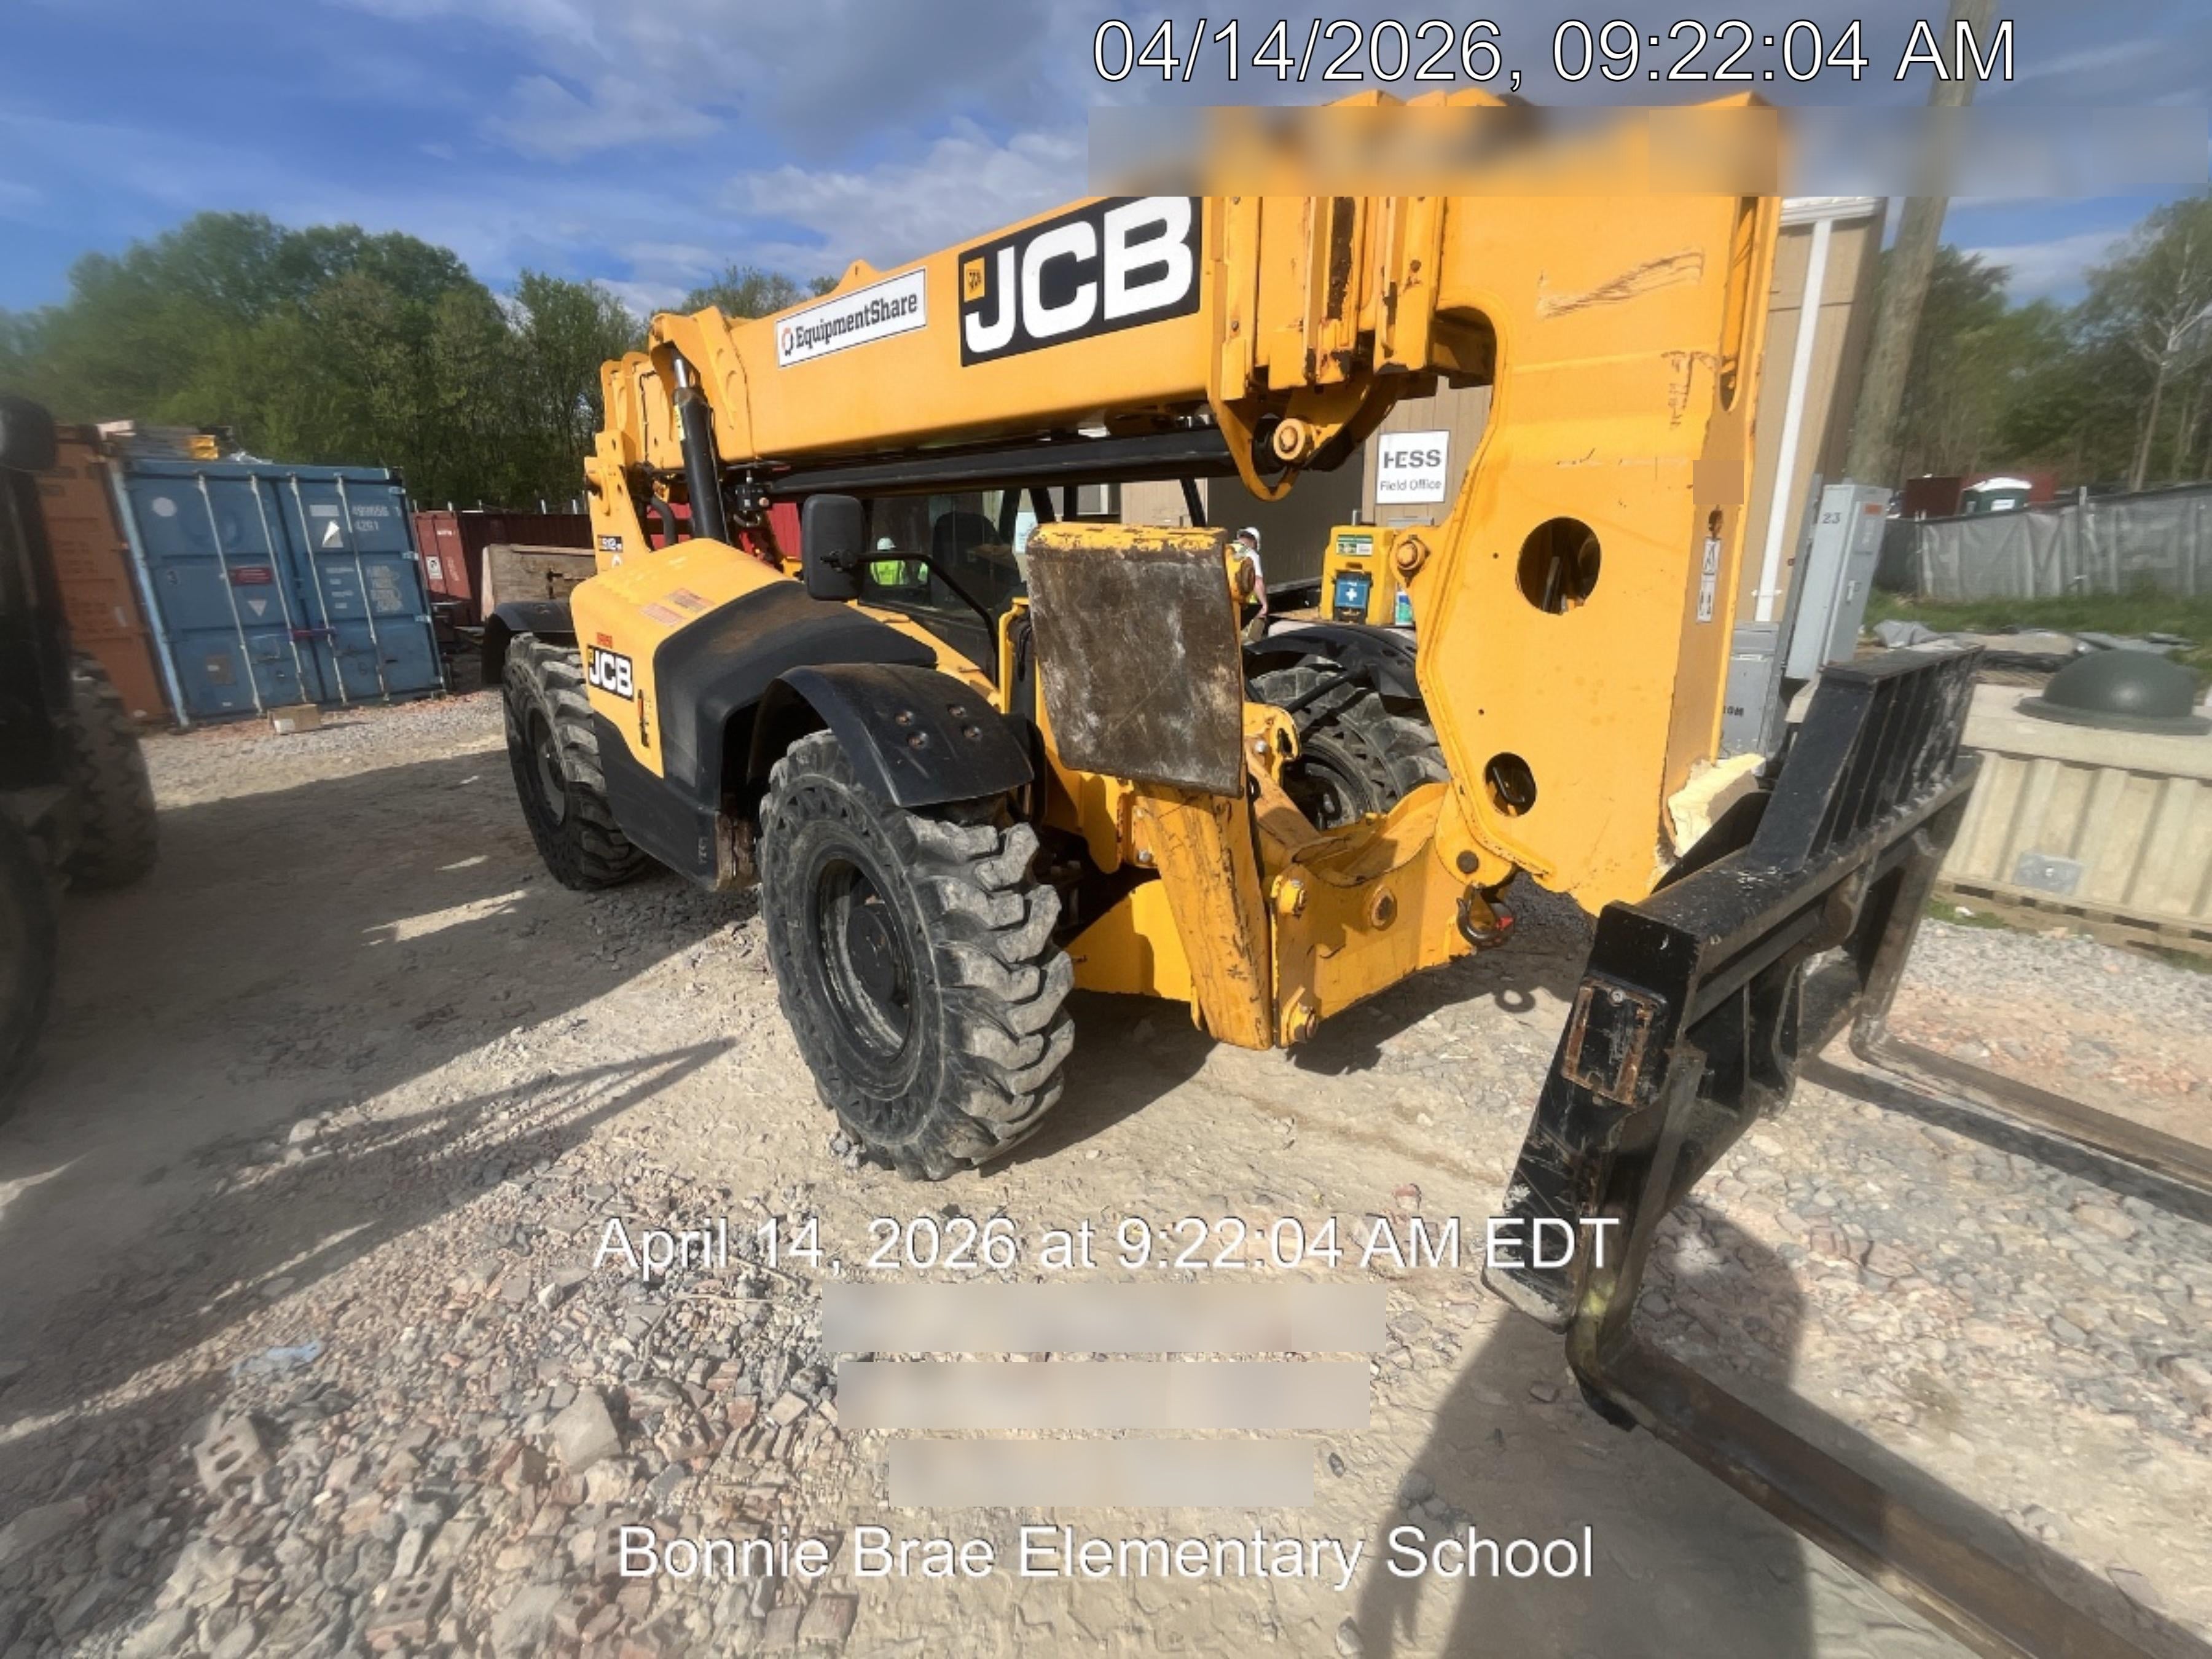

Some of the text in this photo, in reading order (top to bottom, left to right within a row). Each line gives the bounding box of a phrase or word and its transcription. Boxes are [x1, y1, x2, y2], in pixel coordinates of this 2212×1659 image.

[965, 197, 1193, 353] JCB
[796, 294, 917, 349] EquipmentShare
[1384, 449, 1441, 468] HESS
[1380, 478, 1441, 491] Field Office
[589, 650, 633, 697] JCB
